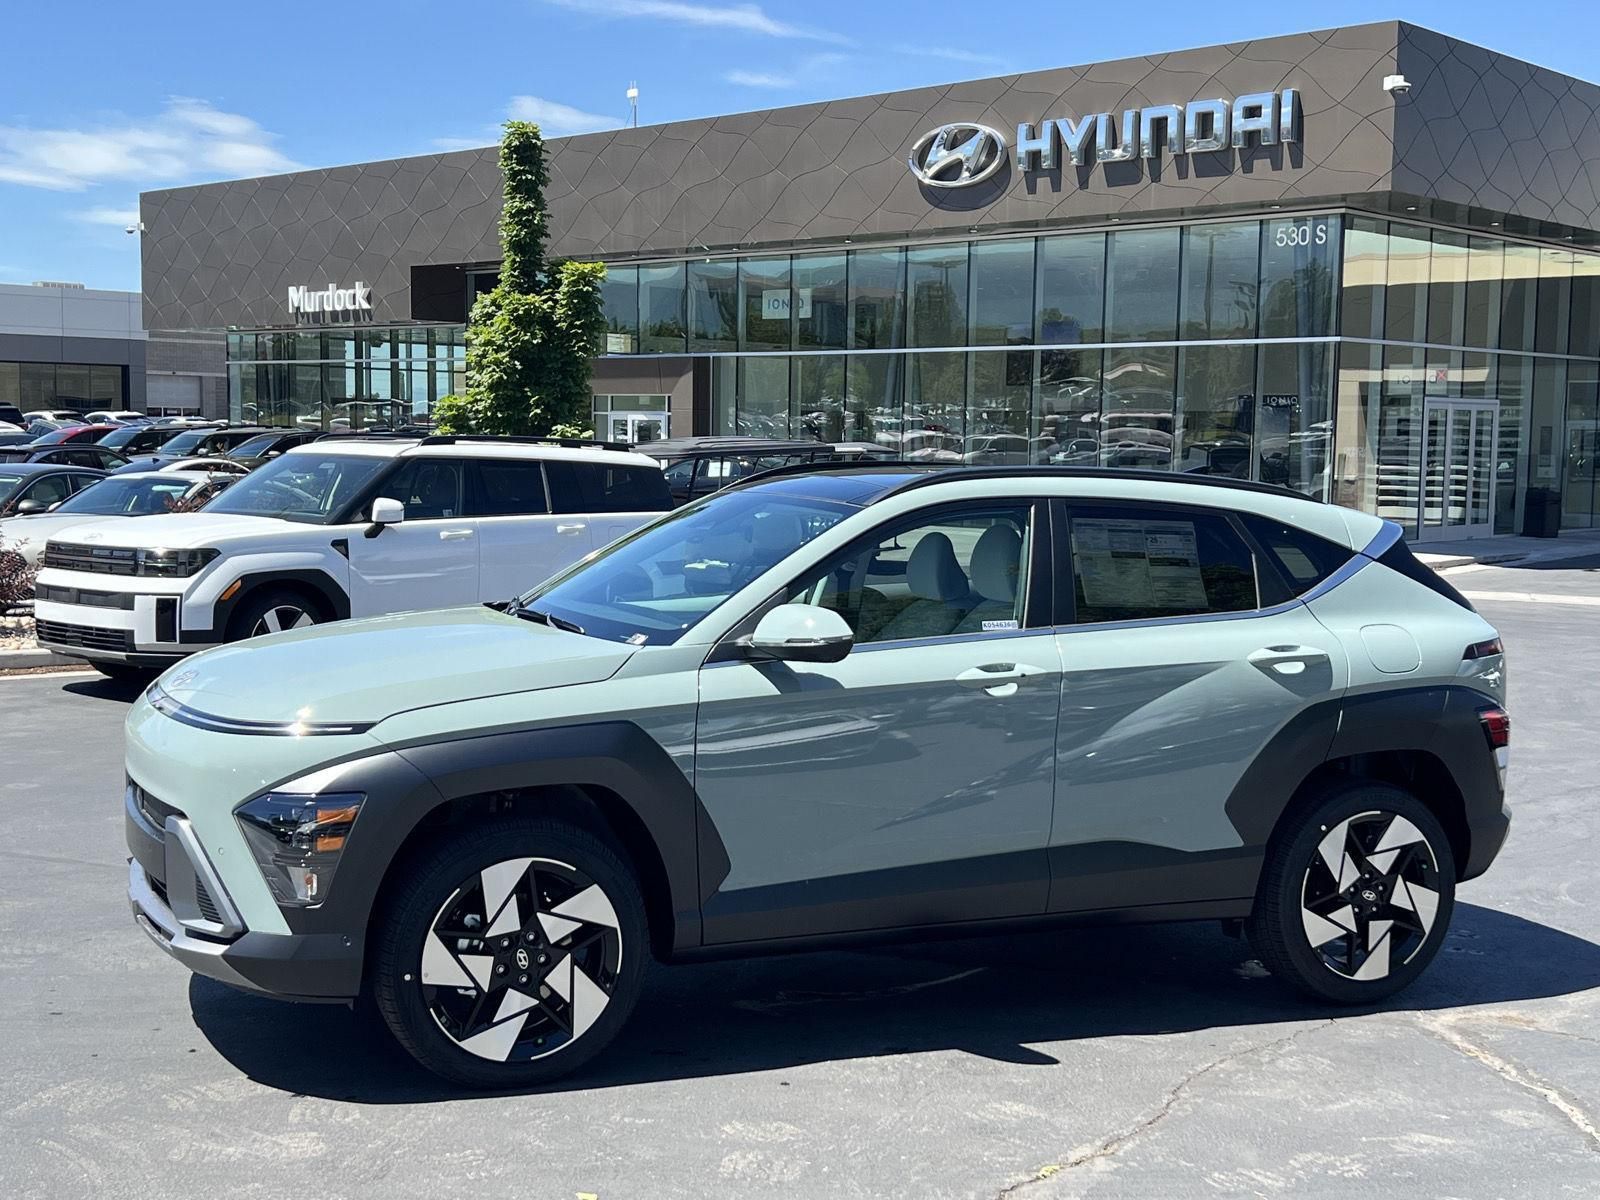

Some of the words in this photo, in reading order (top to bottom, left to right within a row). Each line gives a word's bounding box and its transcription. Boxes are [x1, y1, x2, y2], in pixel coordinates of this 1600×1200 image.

[1016, 88, 1302, 172] HYUNDAI
[1275, 225, 1310, 247] 530
[1315, 224, 1327, 245] S
[287, 281, 372, 313] Murdock
